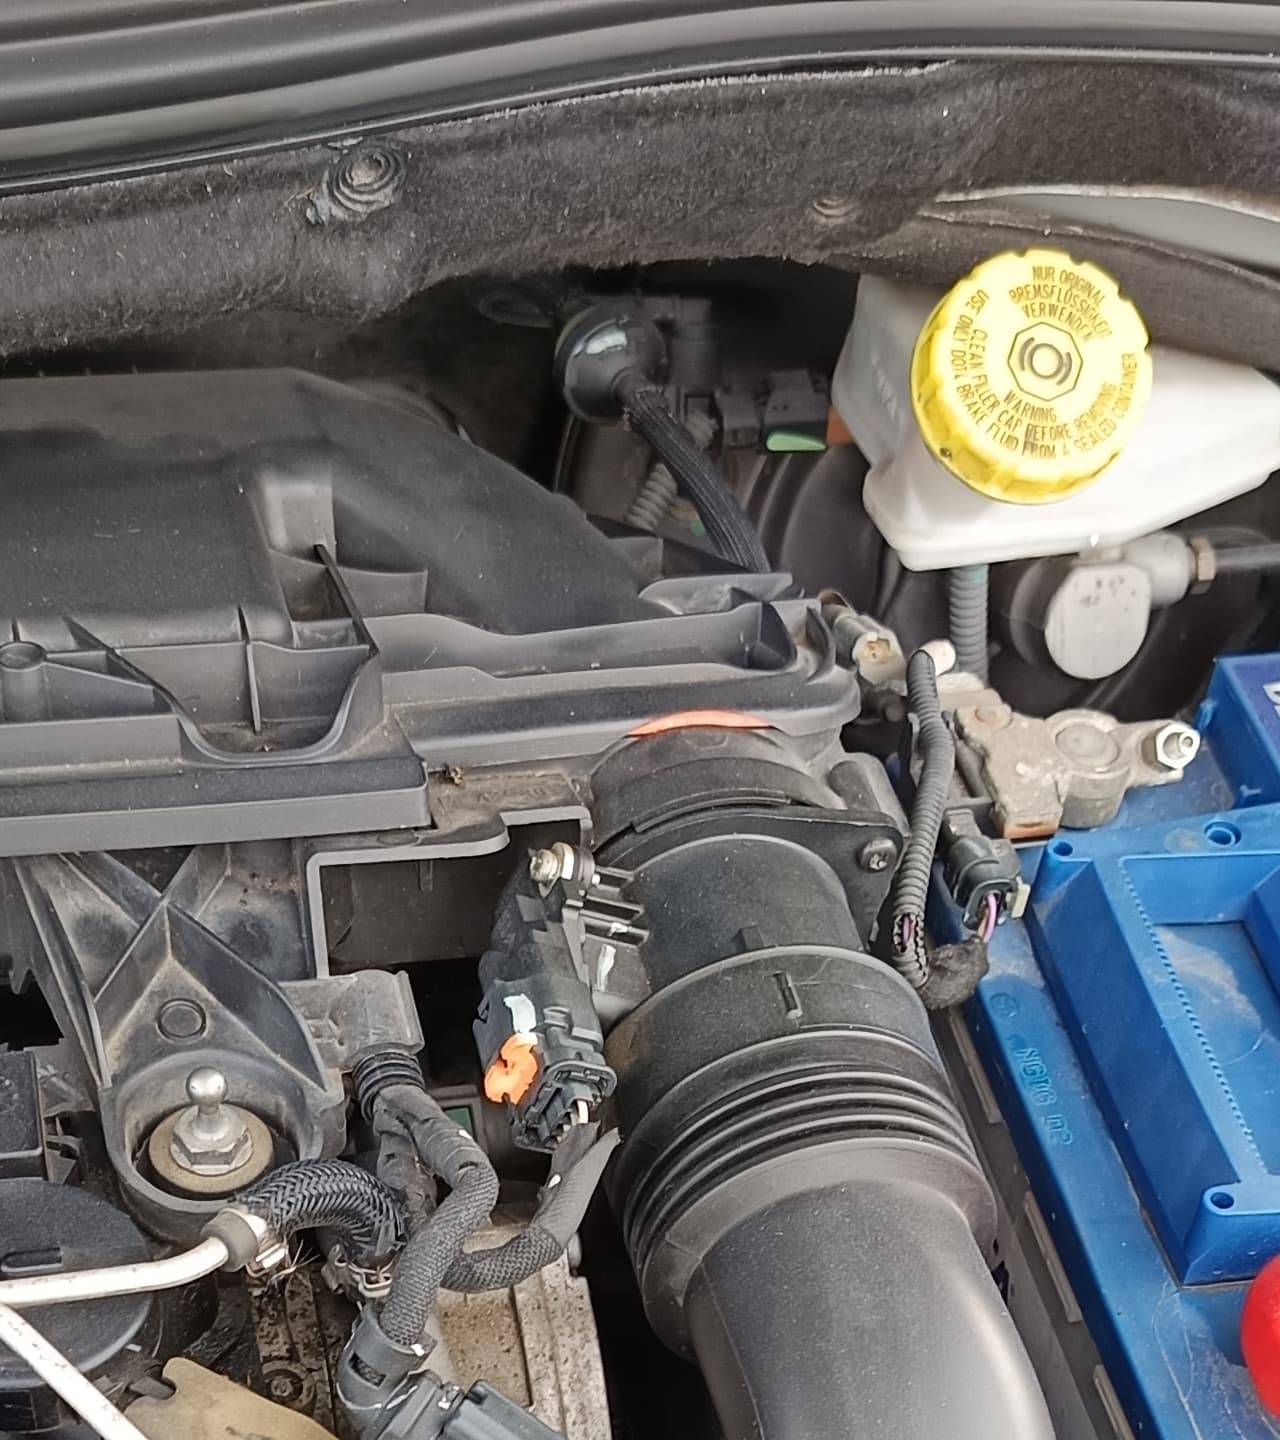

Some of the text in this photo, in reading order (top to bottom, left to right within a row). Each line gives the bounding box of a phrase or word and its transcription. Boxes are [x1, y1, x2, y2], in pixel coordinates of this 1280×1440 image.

[965, 289, 990, 315] USE
[969, 329, 988, 371] CLEAN
[972, 374, 1001, 413] FILLER
[1112, 353, 1138, 419] CONTAINER
[956, 383, 989, 426] BRAKE
[997, 409, 1023, 430] CAP
[1003, 390, 1056, 423] WARNING
[1022, 439, 1056, 458] FROM
[1024, 423, 1072, 442] BEFORE
[1074, 419, 1117, 452] SEALED
